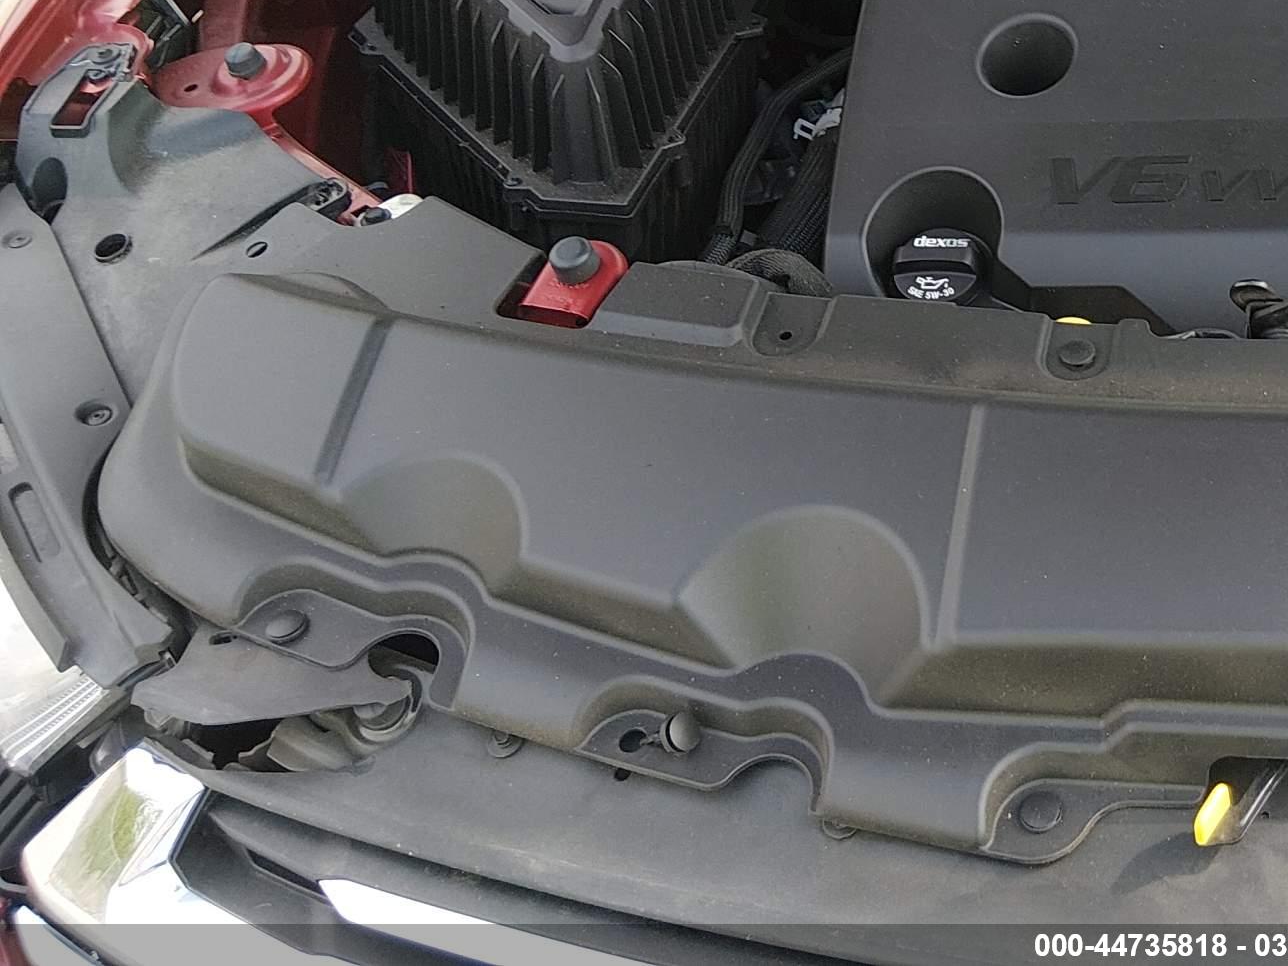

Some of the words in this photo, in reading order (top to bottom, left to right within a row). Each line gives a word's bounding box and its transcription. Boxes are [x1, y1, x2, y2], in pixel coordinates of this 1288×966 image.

[1047, 154, 1193, 206] V6
[913, 235, 972, 248] dexos
[907, 286, 925, 299] SAE
[924, 286, 955, 300] 5W-30
